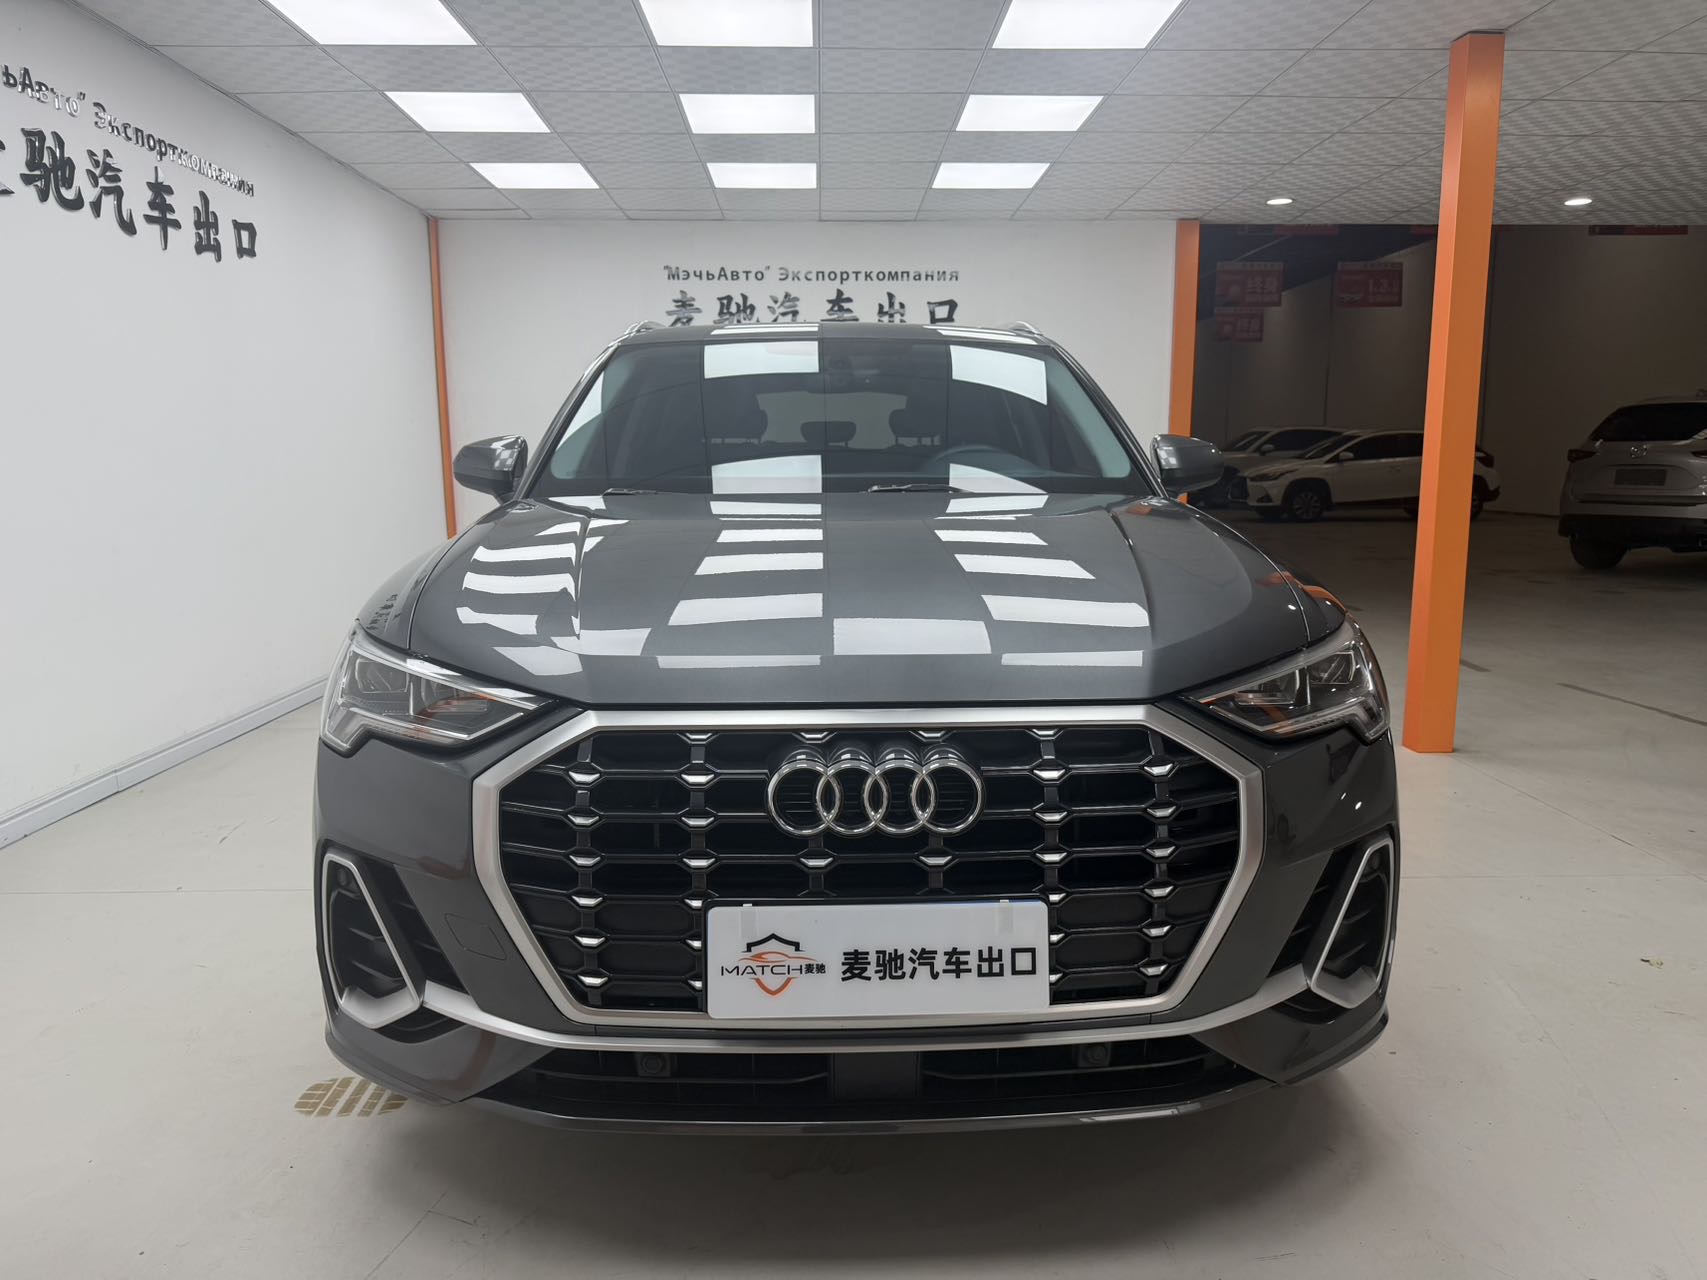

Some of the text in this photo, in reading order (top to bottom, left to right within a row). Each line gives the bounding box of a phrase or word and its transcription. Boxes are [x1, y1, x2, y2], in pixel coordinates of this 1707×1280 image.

[0, 127, 257, 262] 驰汽车出口
[778, 267, 959, 285] Экспорткомпания
[841, 946, 1037, 982] 麦驰汽车出口
